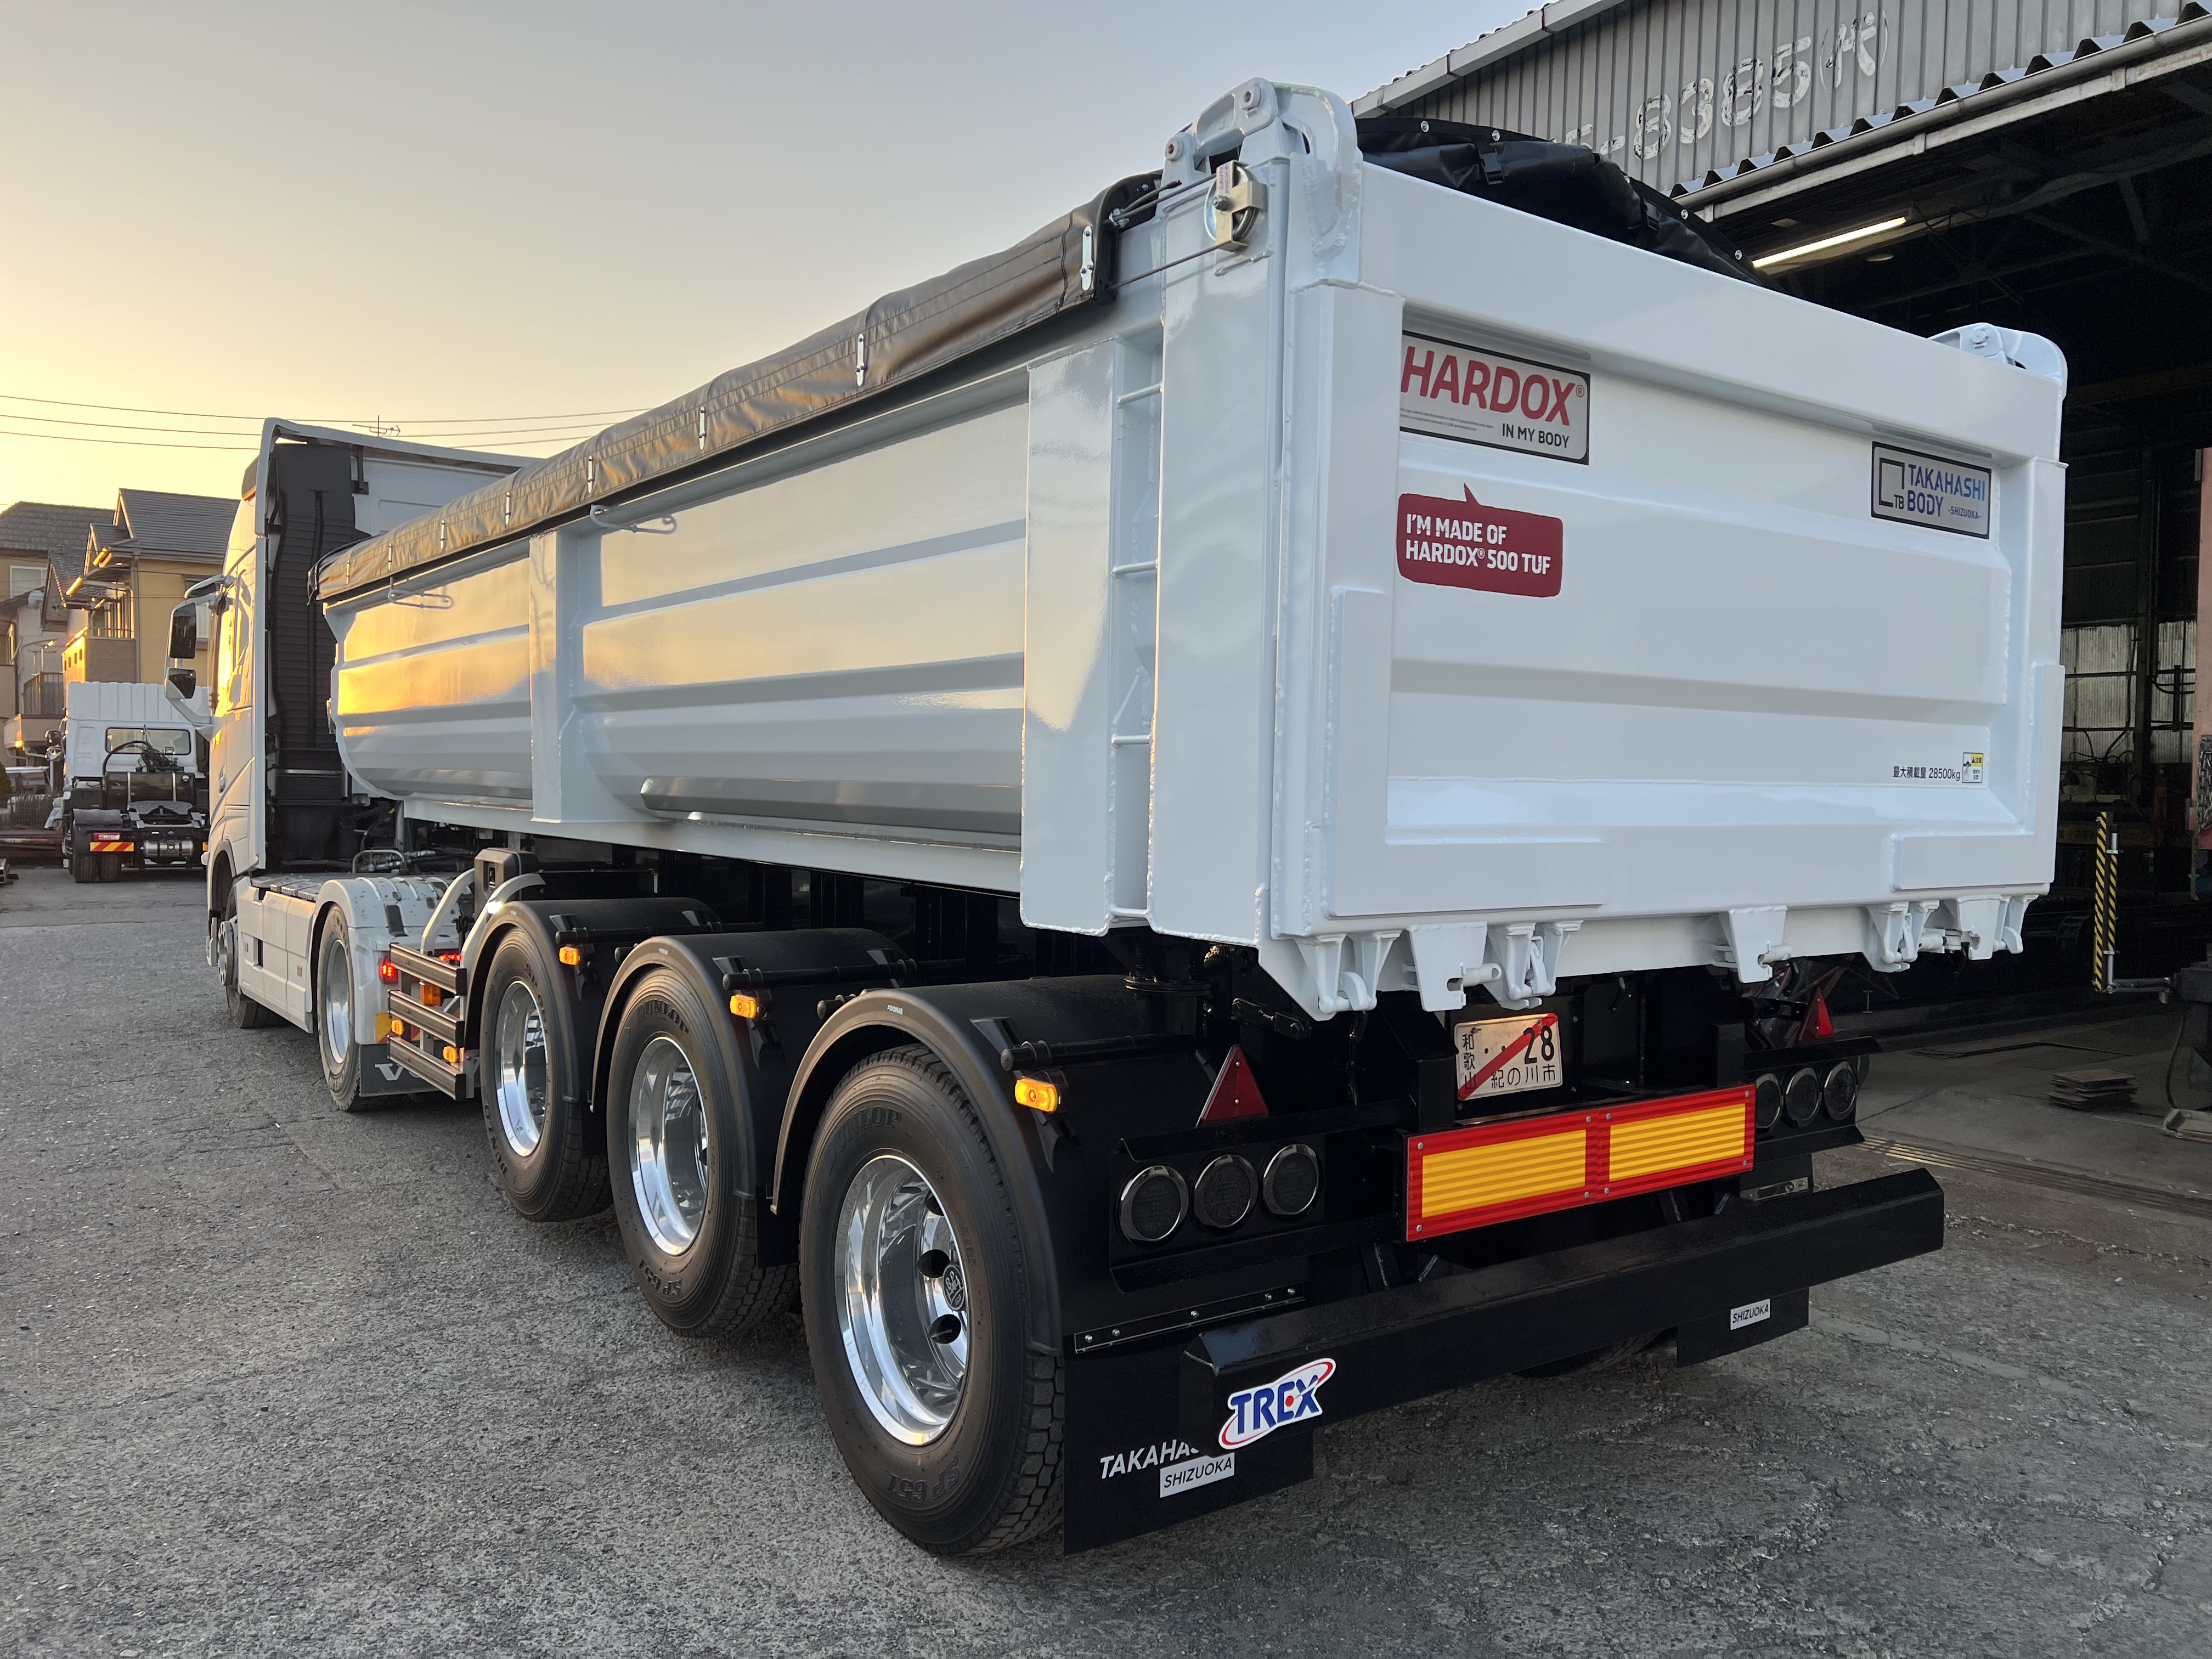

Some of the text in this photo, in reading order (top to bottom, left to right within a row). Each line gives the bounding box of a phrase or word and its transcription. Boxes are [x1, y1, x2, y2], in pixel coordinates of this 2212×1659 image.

[1502, 423, 1570, 449] IN MY BODY
[1908, 464, 1985, 501] TAKAHASHI
[1907, 490, 1944, 517] BODY
[1406, 514, 1508, 545] I'M MADE OF
[1487, 549, 1519, 572] 500
[1521, 554, 1551, 574] TUF
[1893, 766, 1961, 782] 最大積載量 28500kg
[1462, 1033, 1477, 1090] 和歌山
[1491, 1063, 1556, 1089] 紀の川市
[825, 1105, 902, 1176] DUNLOP
[1732, 1304, 1769, 1323] SHIZUOKA
[1231, 1375, 1321, 1435] TREX
[1099, 1439, 1199, 1480] TAKAHA
[1163, 1457, 1232, 1488] SHIZUOKA
[933, 1453, 960, 1500] SP
